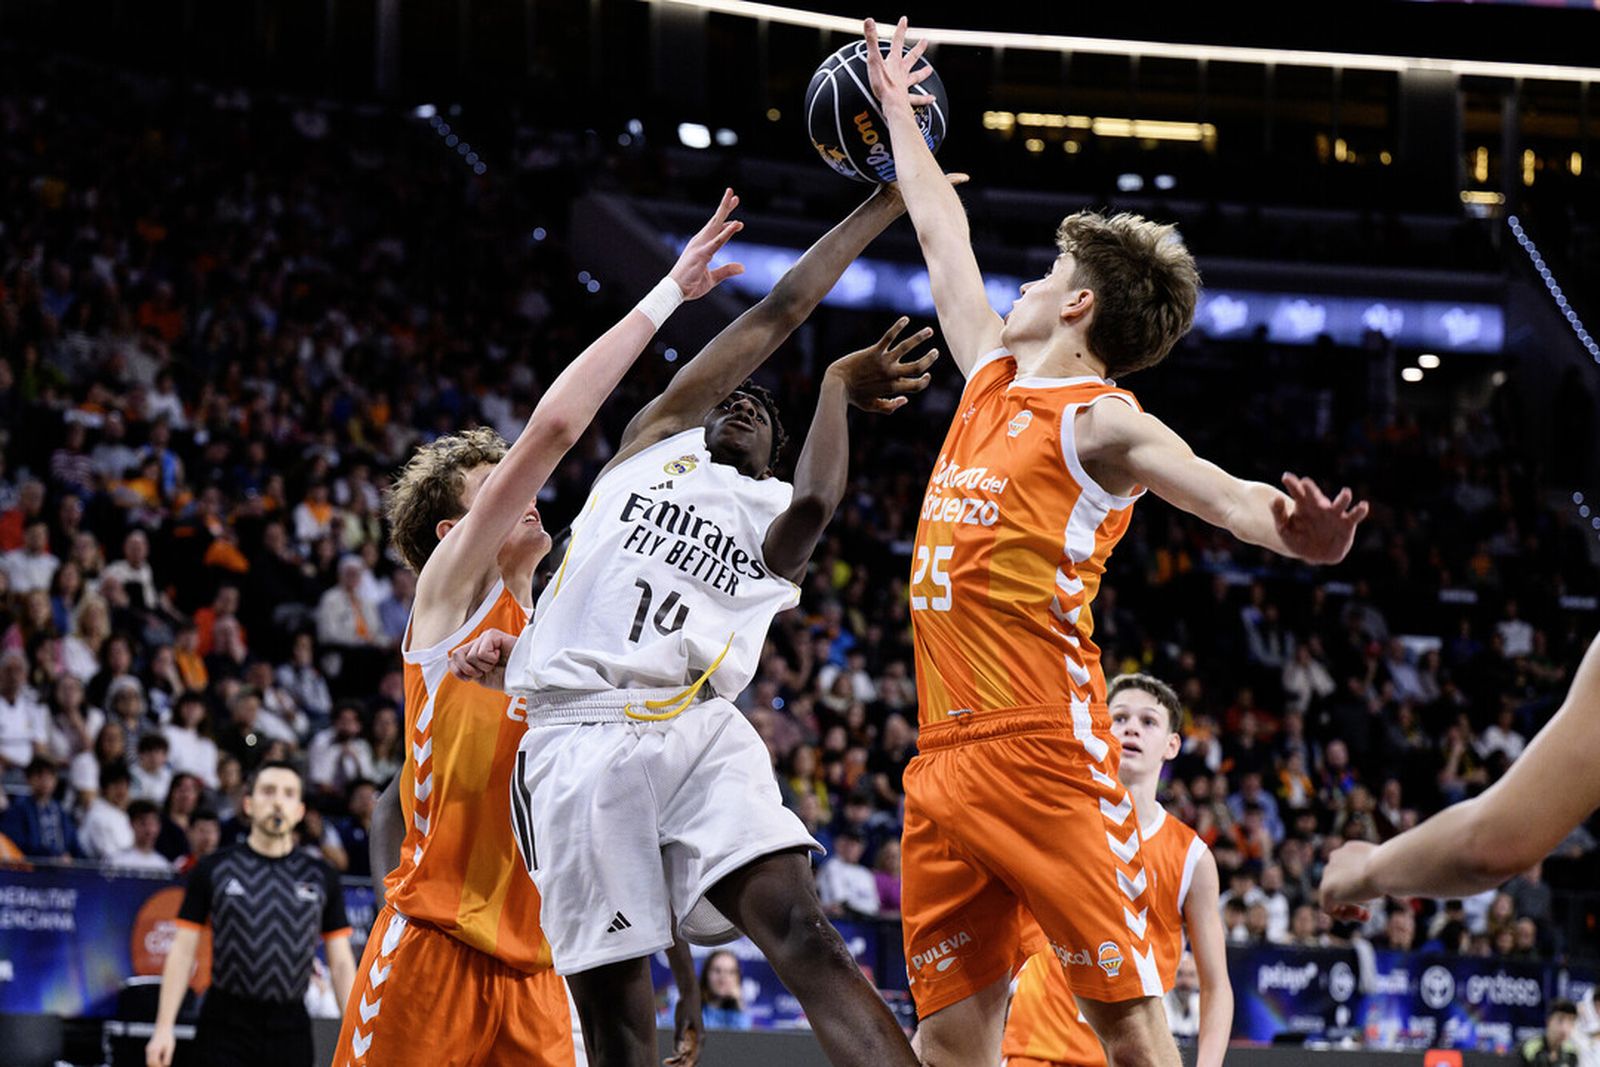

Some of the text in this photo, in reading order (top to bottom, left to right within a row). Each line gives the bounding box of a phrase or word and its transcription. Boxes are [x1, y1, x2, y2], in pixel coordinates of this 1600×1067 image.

[921, 486, 1000, 527] fuerzo
[979, 476, 1009, 494] del
[619, 492, 766, 581] Emirates
[623, 524, 740, 597] FLY BETTER
[628, 577, 690, 644] 14
[911, 545, 955, 611] 25
[911, 931, 972, 970] PULEVA
